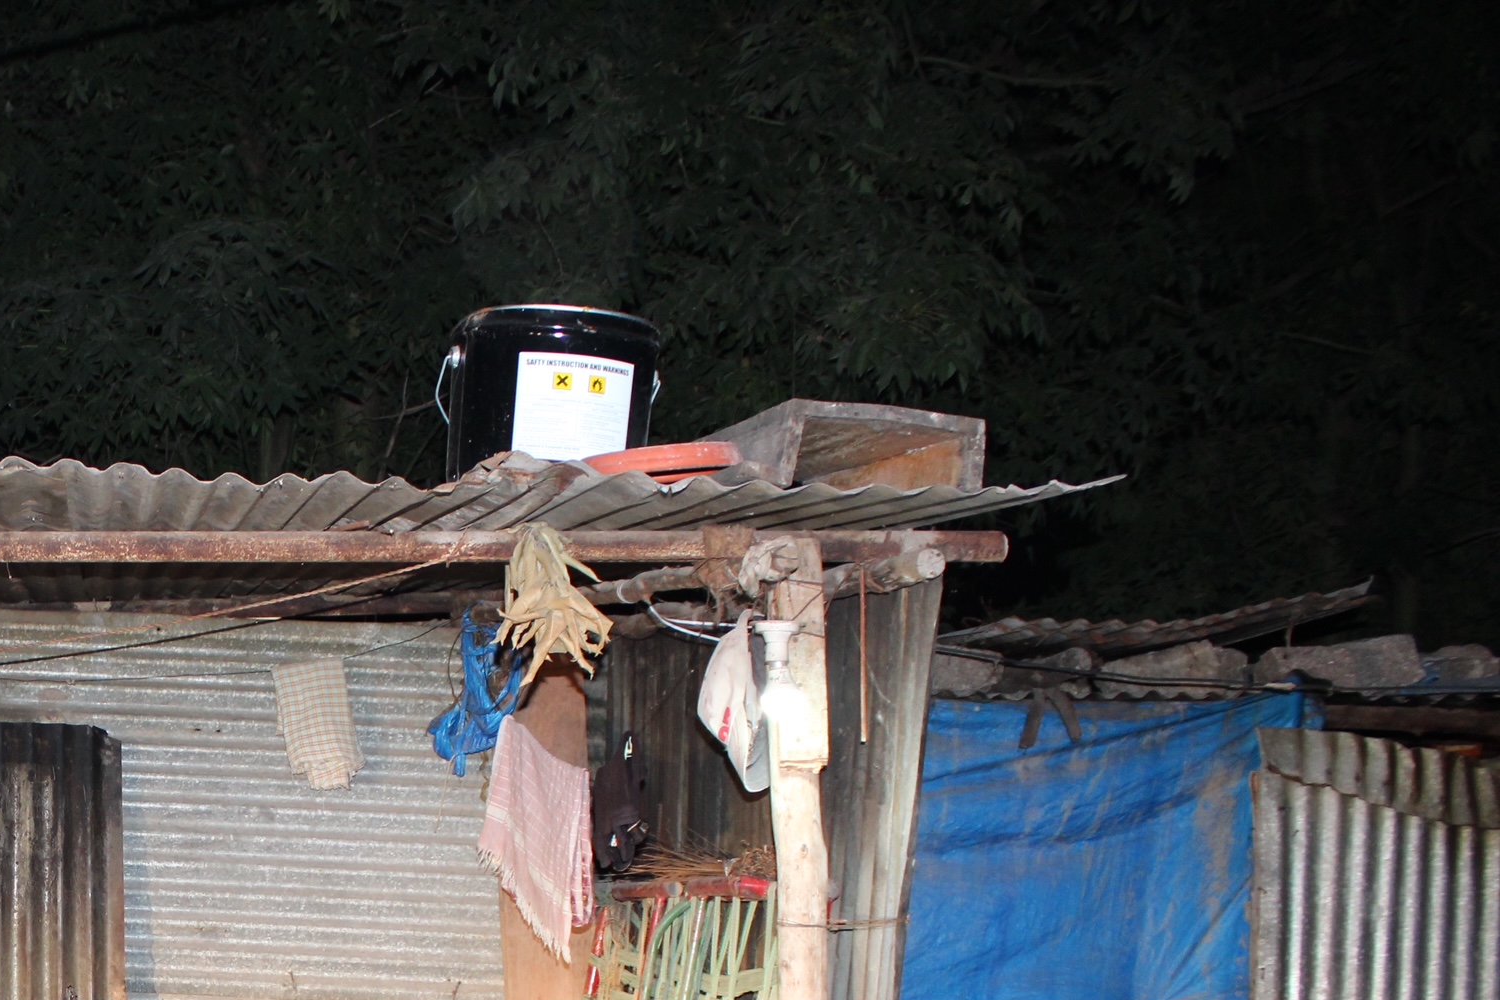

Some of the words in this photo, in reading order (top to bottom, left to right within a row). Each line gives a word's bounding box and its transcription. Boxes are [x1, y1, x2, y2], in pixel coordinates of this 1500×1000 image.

[526, 358, 545, 366] SAFTY
[546, 359, 589, 370] INSTRUCTION
[589, 363, 601, 371] AND
[602, 365, 630, 377] WARNINGS
